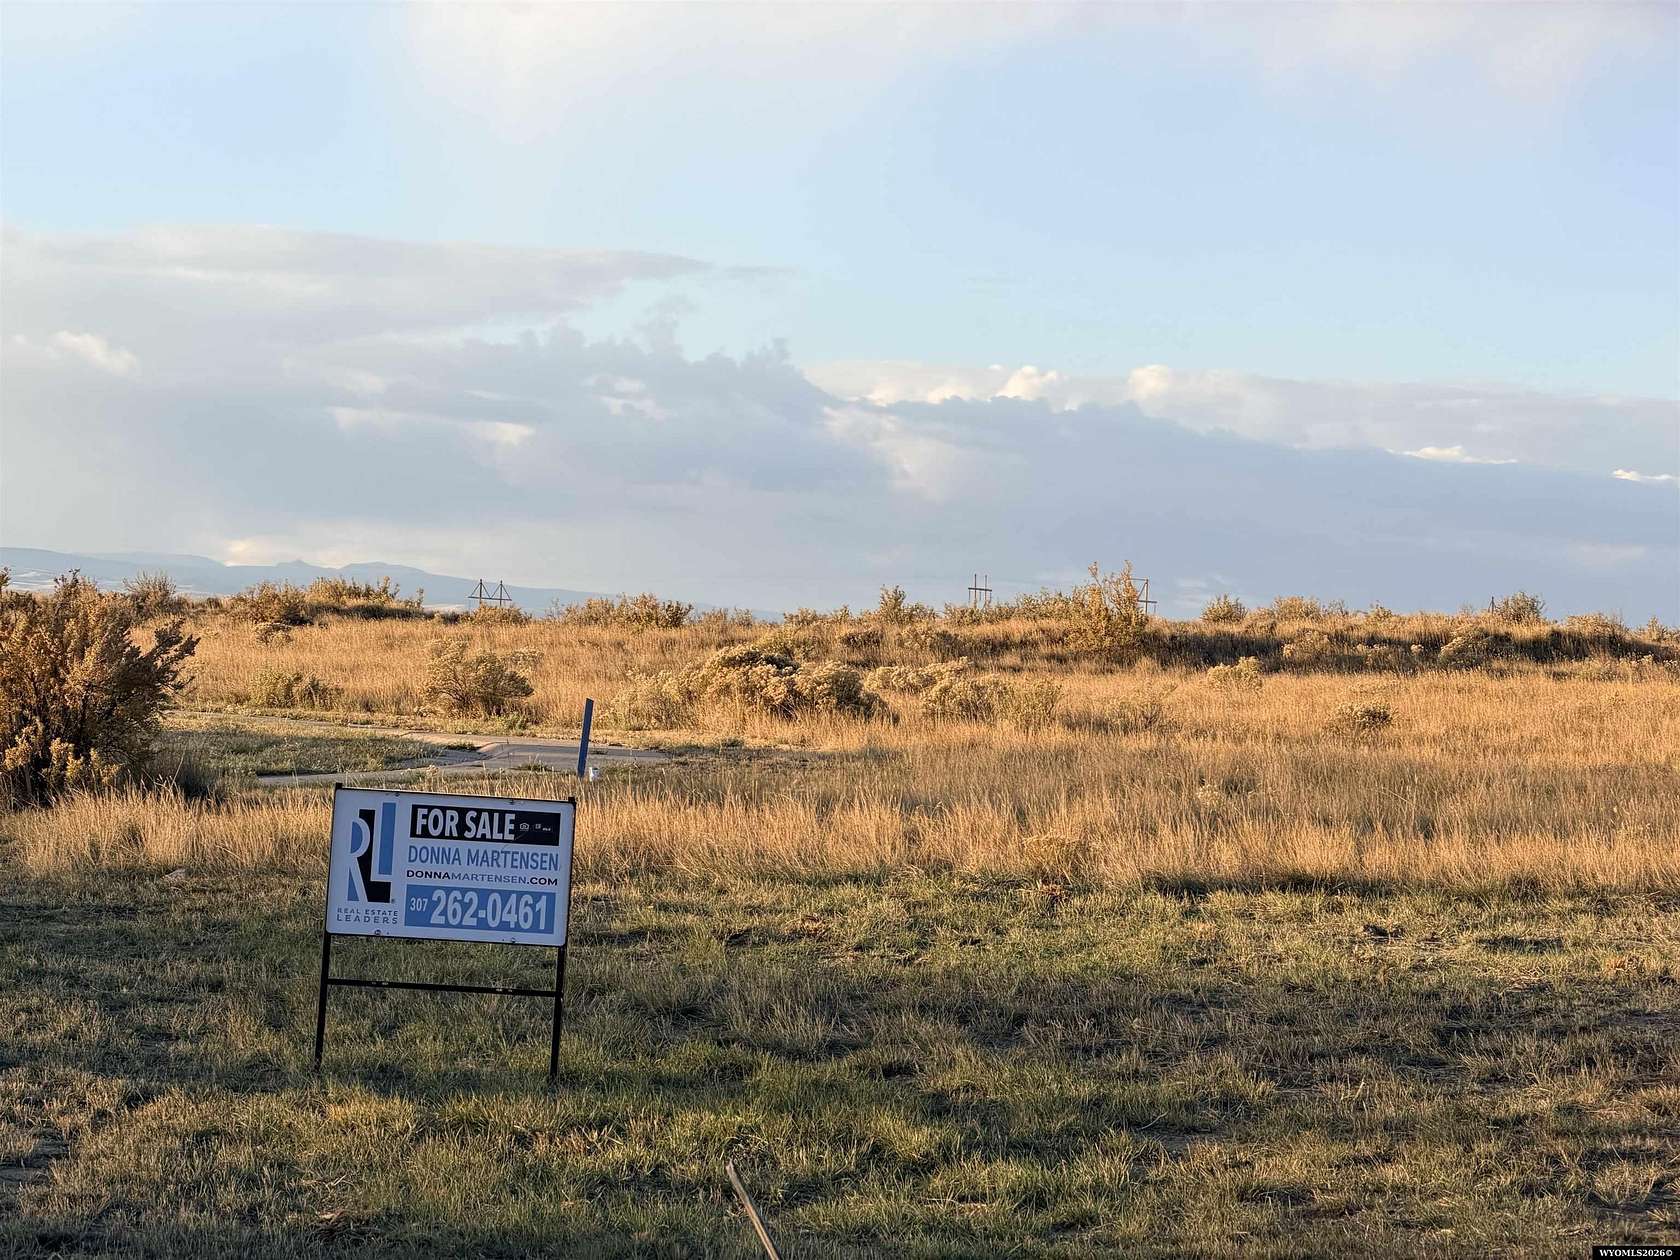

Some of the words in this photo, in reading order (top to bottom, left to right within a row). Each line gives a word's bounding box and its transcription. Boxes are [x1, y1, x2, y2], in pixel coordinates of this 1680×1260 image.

[416, 808, 459, 837] FOR
[464, 810, 516, 841] SALE
[408, 845, 462, 866] DONNA
[466, 848, 559, 871] MARTENSEN
[406, 869, 559, 886] DONNAMARTENSEN.COM
[336, 914, 398, 925] LEADERS
[337, 907, 361, 915] REAL
[365, 909, 399, 917] ESTATE
[410, 897, 429, 912] 307
[430, 889, 547, 930] 262-0461
